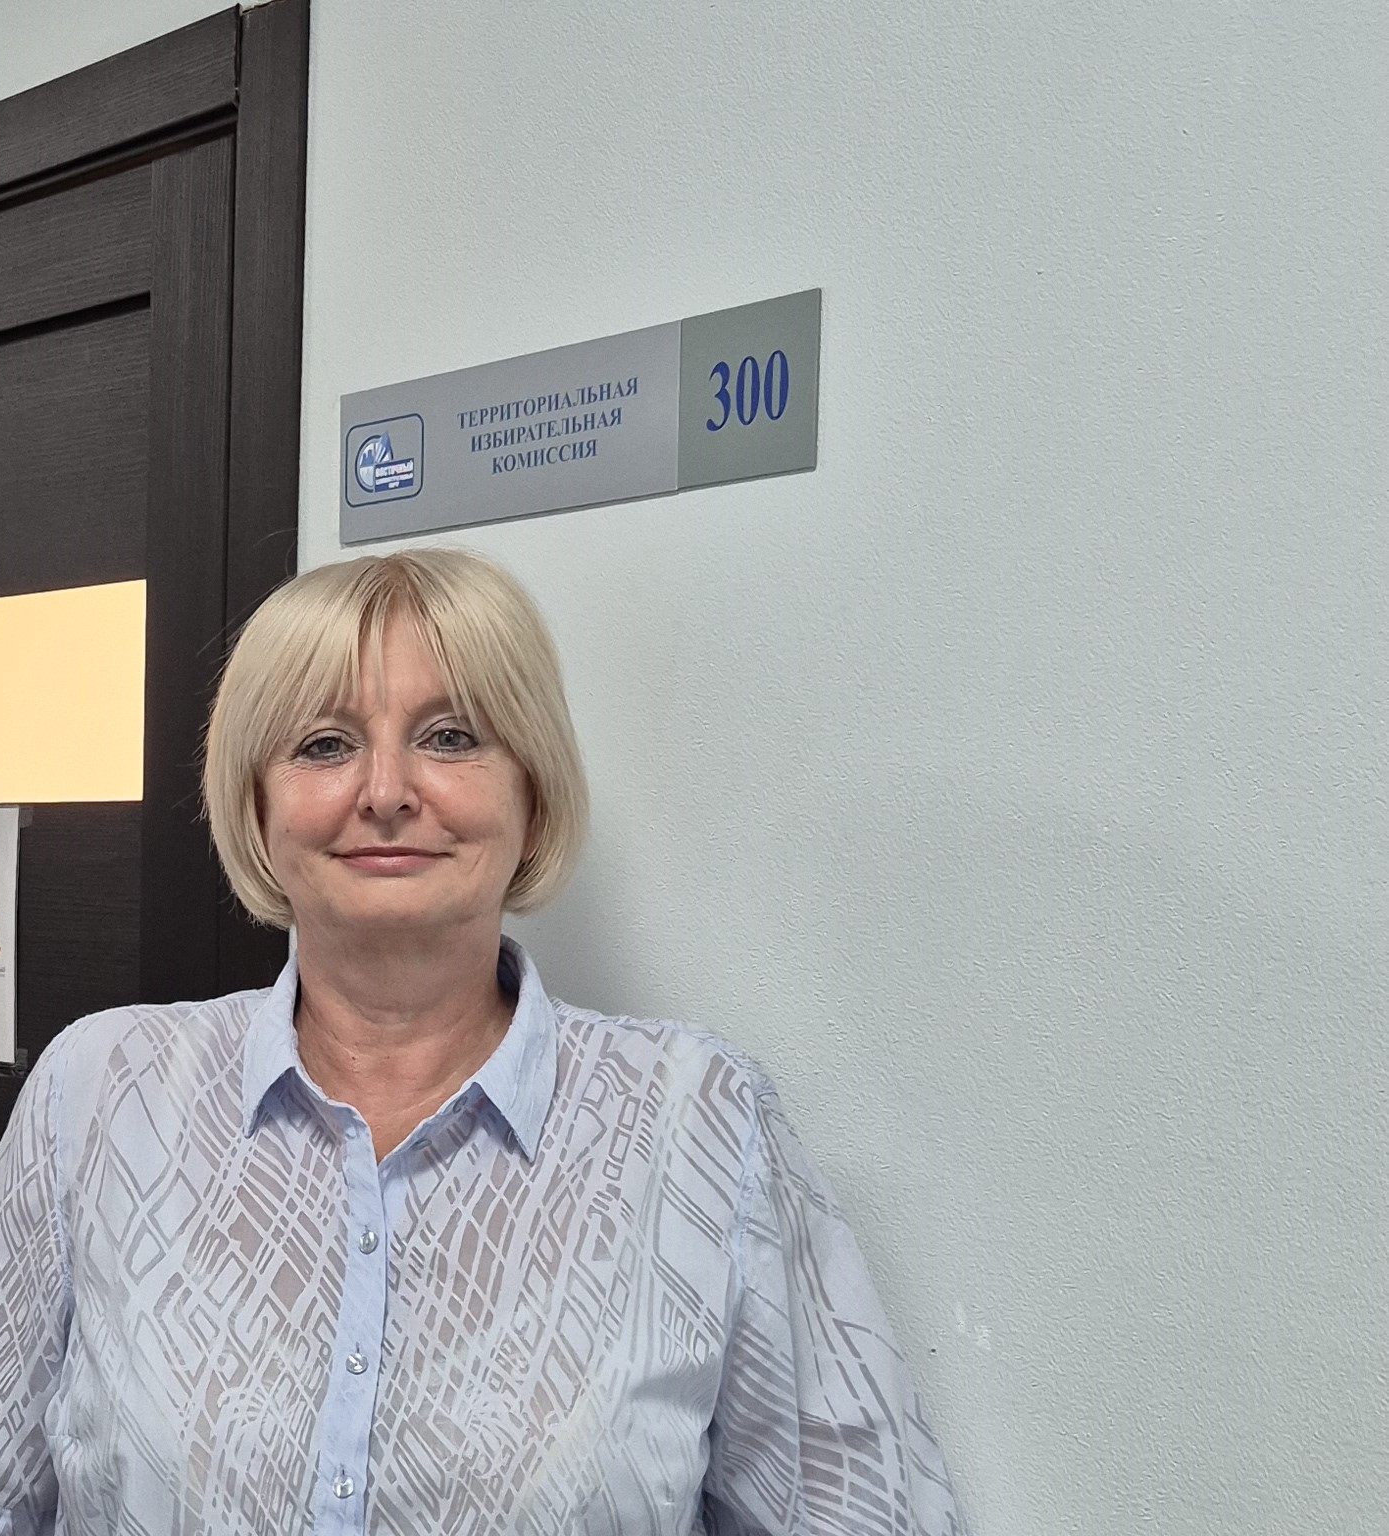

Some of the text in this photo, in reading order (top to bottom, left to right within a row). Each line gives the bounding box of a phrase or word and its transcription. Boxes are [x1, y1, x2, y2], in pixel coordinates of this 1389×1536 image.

[457, 377, 638, 430] ТЕРРИТОРИАЛЬНАЯ
[706, 350, 789, 431] 300
[471, 407, 622, 452] ИЗБИРАТЕЛЬНАЯ
[491, 439, 598, 475] КОМИССИЯ
